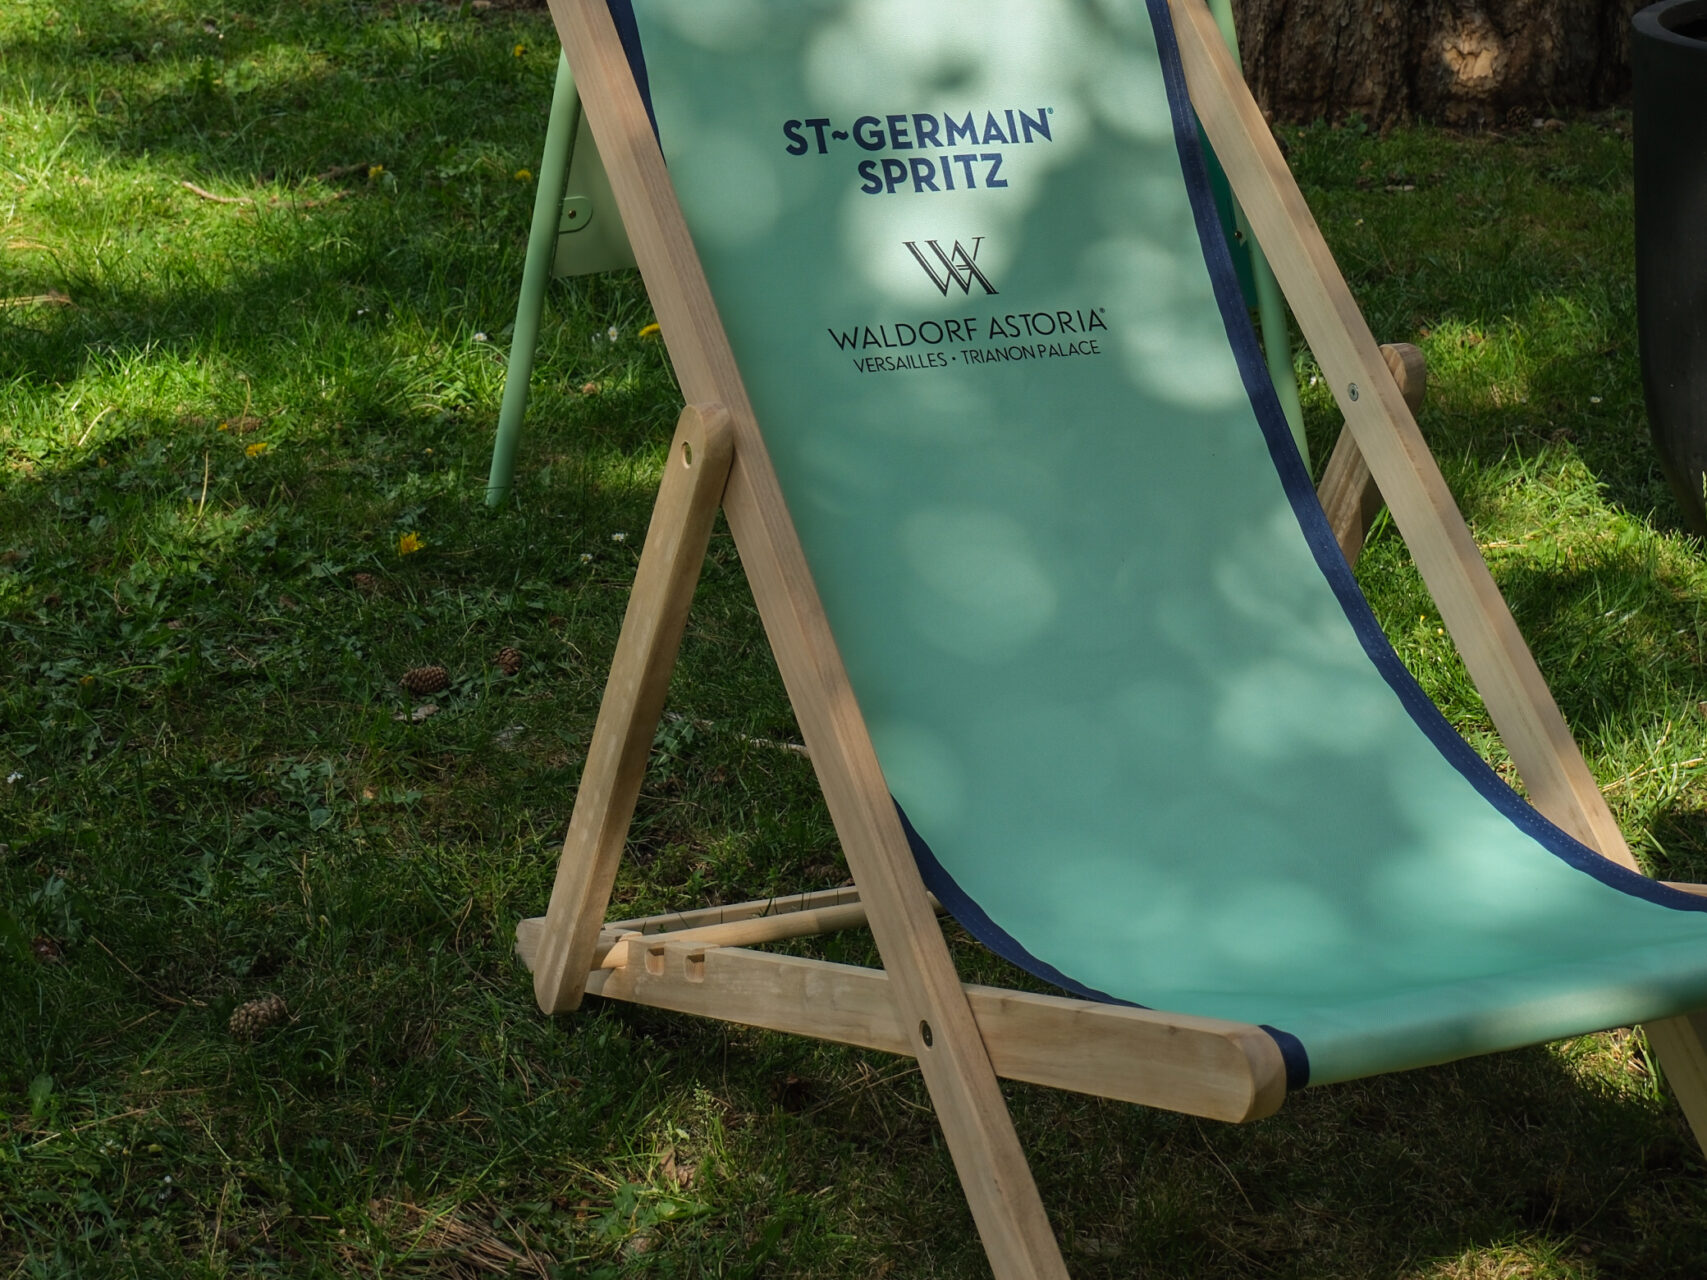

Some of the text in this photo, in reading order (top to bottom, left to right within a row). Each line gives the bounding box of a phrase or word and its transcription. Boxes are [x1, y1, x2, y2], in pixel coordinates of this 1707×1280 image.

[857, 153, 1009, 195] SPRITZ
[828, 318, 977, 351] WALDORF
[853, 340, 1101, 373] VERSAILLES TRIANON PALACE
